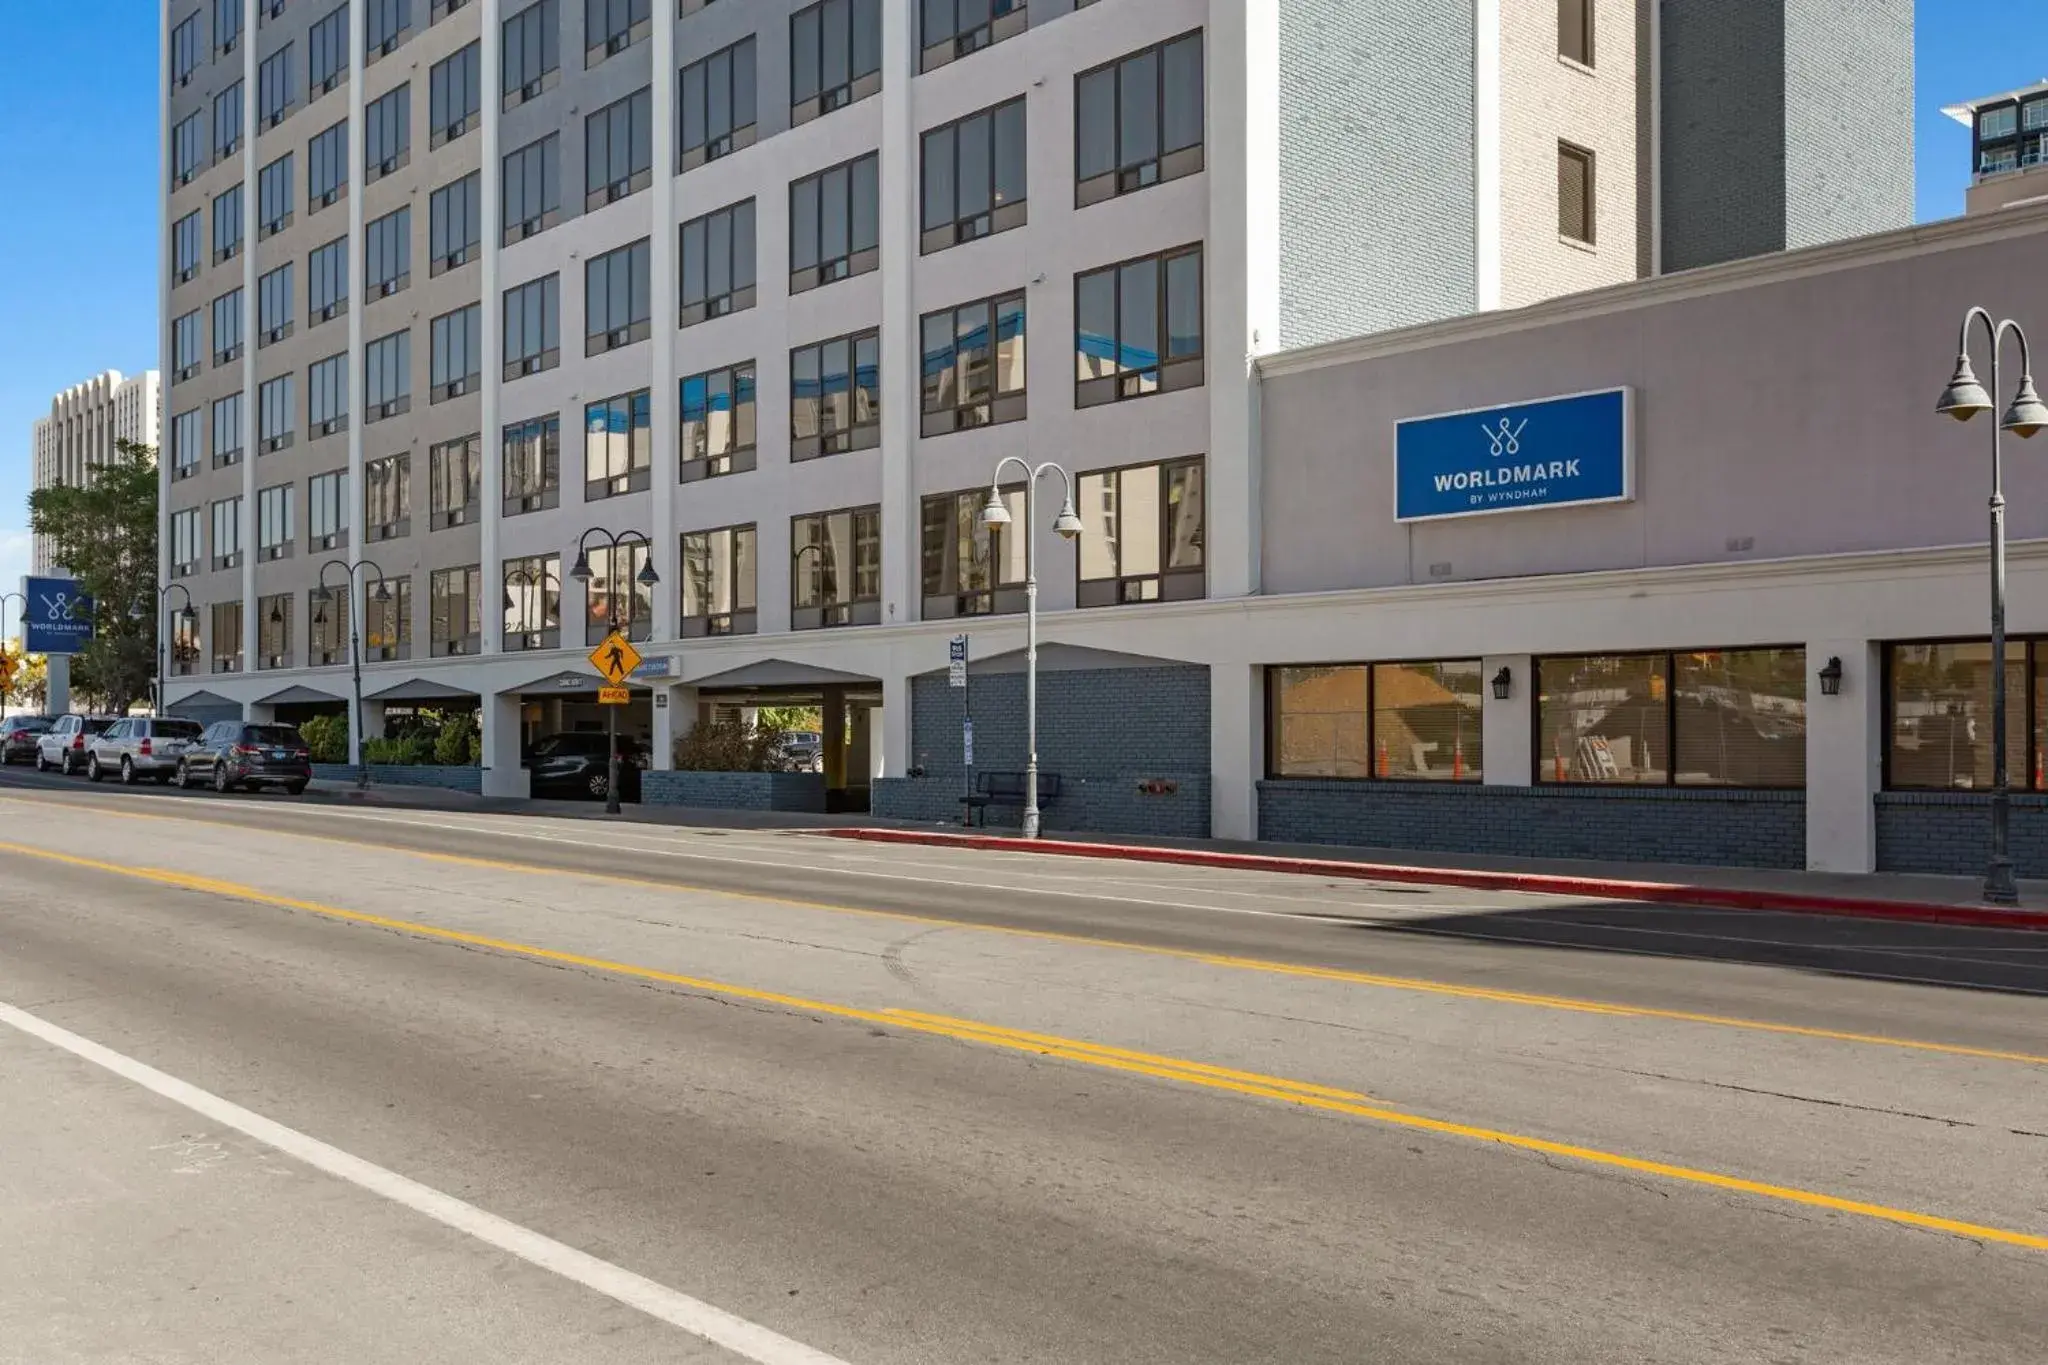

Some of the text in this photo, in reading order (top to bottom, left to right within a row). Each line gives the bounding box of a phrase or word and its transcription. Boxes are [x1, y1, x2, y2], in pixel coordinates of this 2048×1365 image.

[1434, 459, 1580, 491] WORLDMARK
[1470, 488, 1547, 504] BY WYNDHAM
[602, 691, 627, 699] AHEAD
